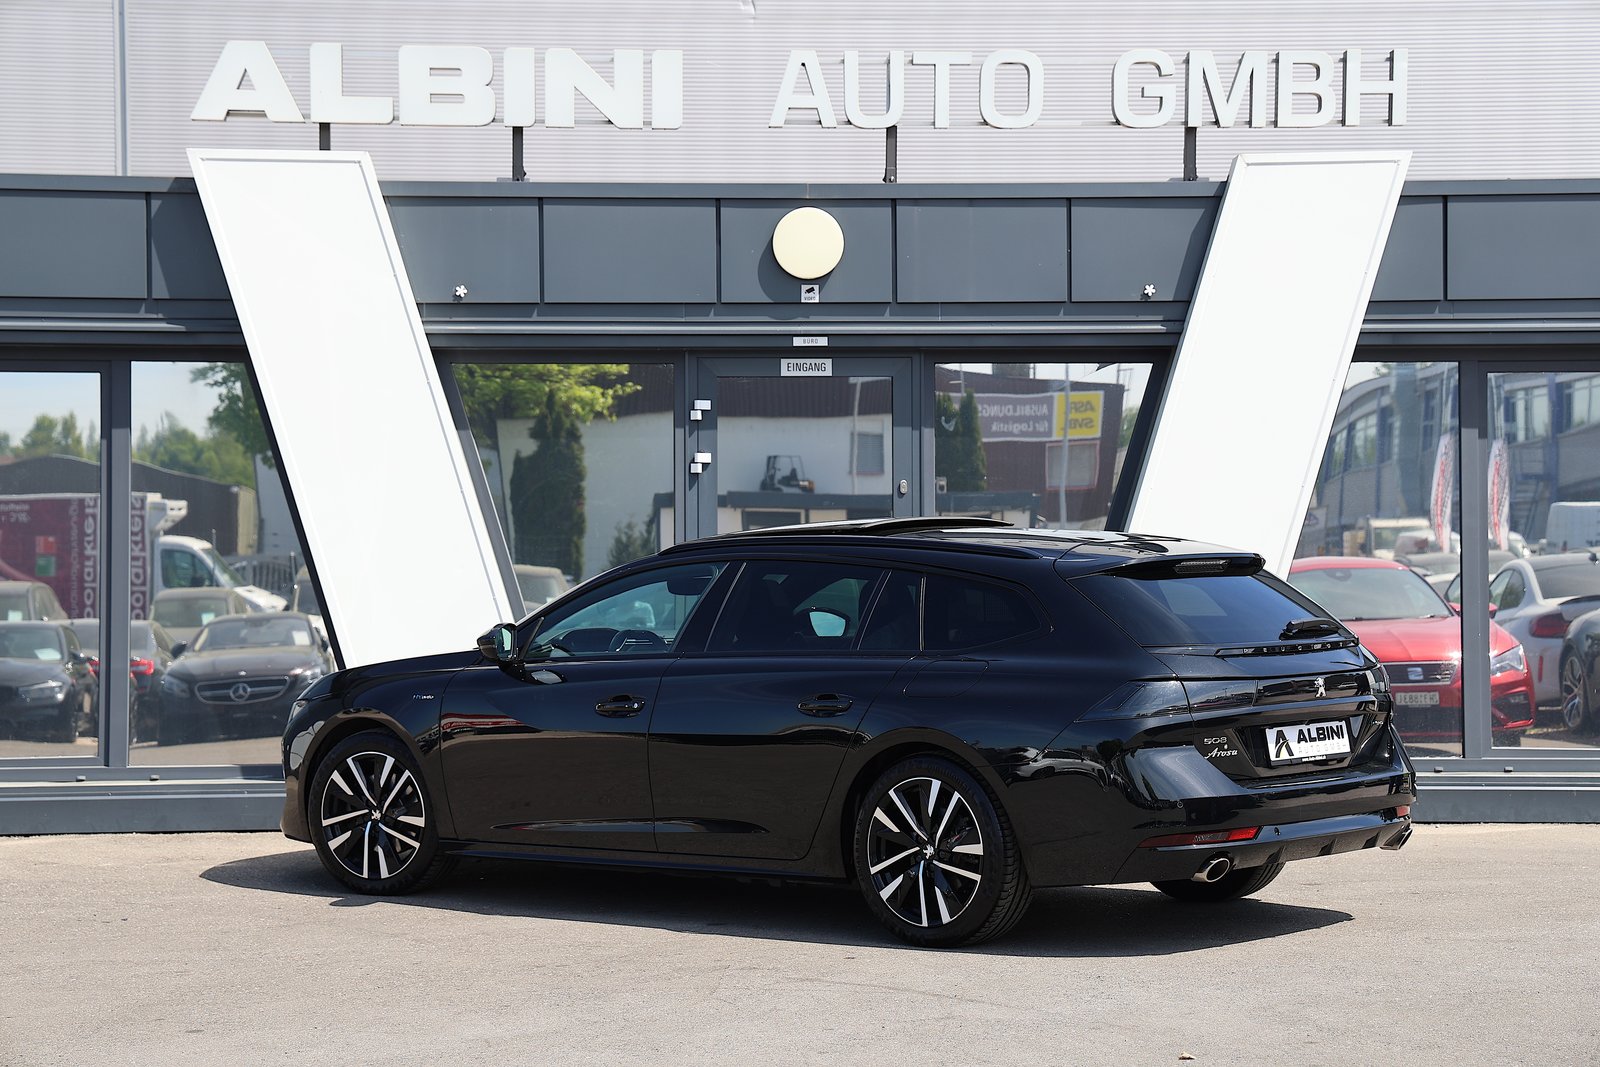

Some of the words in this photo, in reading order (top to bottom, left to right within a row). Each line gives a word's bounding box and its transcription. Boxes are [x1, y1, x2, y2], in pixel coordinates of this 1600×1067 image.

[190, 40, 684, 129] ALBINI
[768, 49, 1045, 129] AUTO
[1111, 48, 1409, 128] GMBH
[786, 362, 827, 372] EINGANG
[1297, 724, 1345, 744] ALBINI
[1203, 736, 1228, 745] 508
[1203, 747, 1238, 759] Arosa
